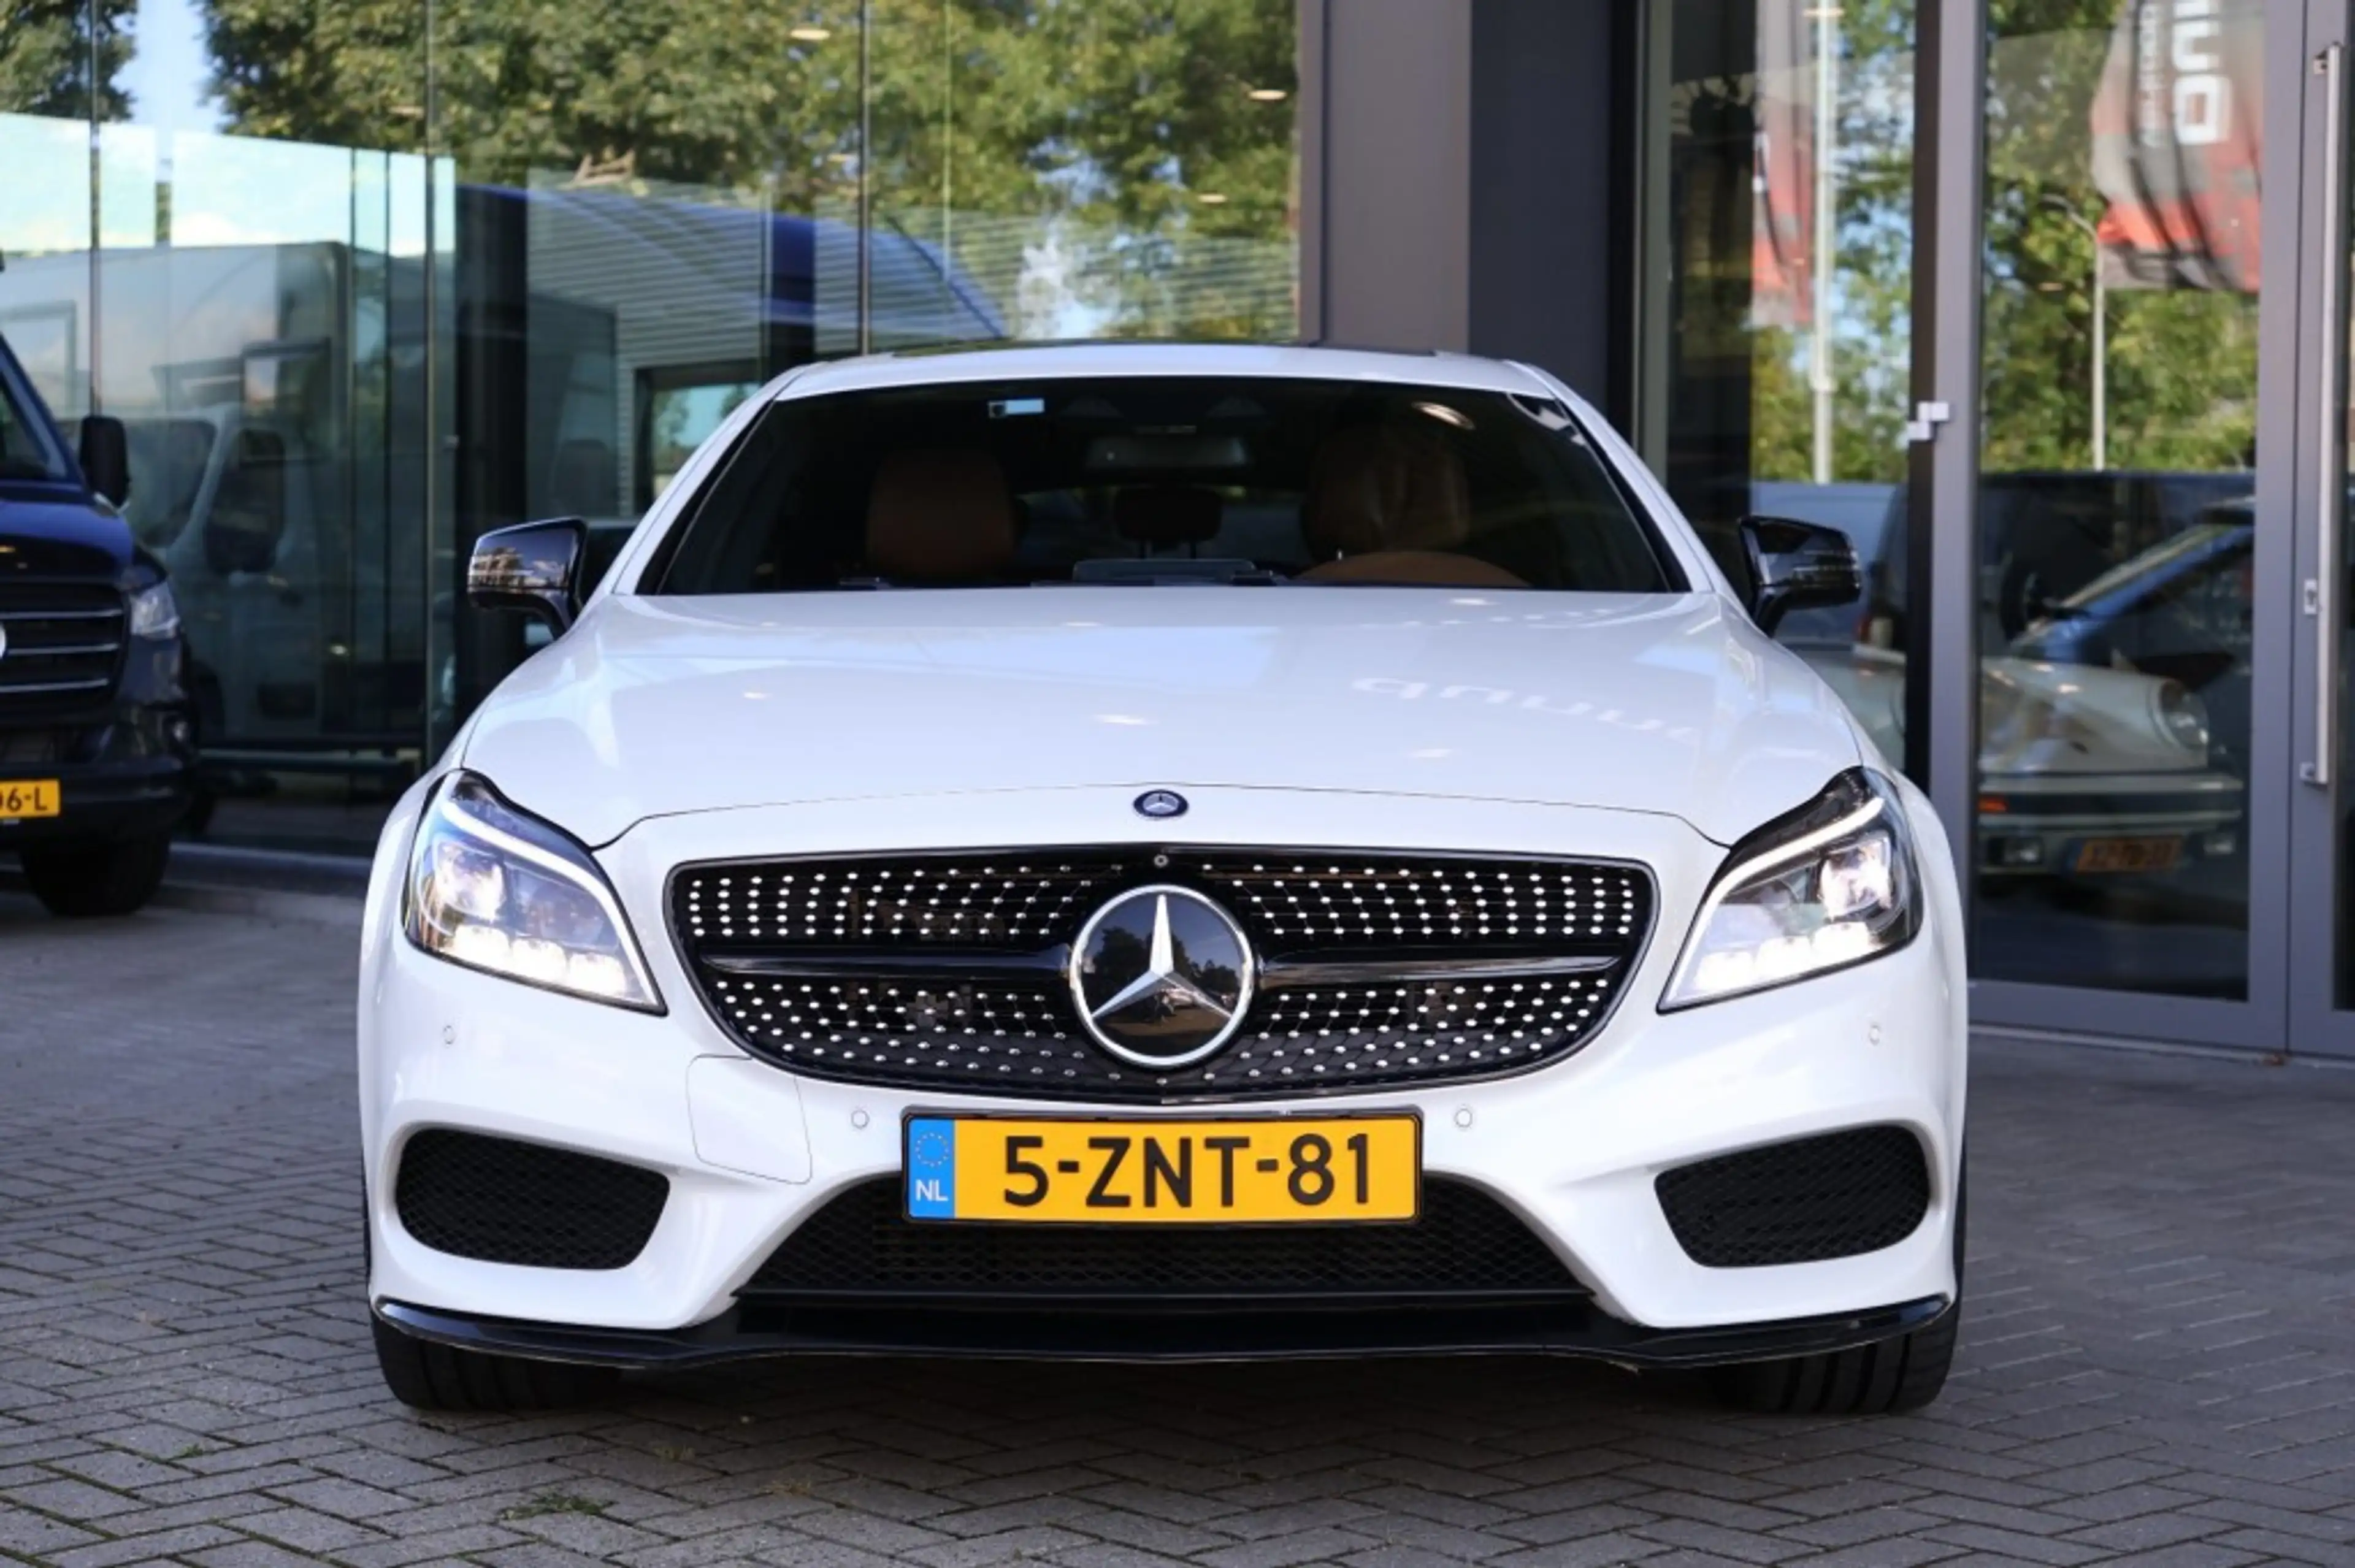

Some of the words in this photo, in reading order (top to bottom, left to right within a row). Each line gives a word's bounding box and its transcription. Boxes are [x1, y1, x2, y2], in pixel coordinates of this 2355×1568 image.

[0, 787, 48, 813] 6-L
[1004, 1133, 1368, 1208] 5-ZNT-81
[916, 1179, 949, 1201] NL
